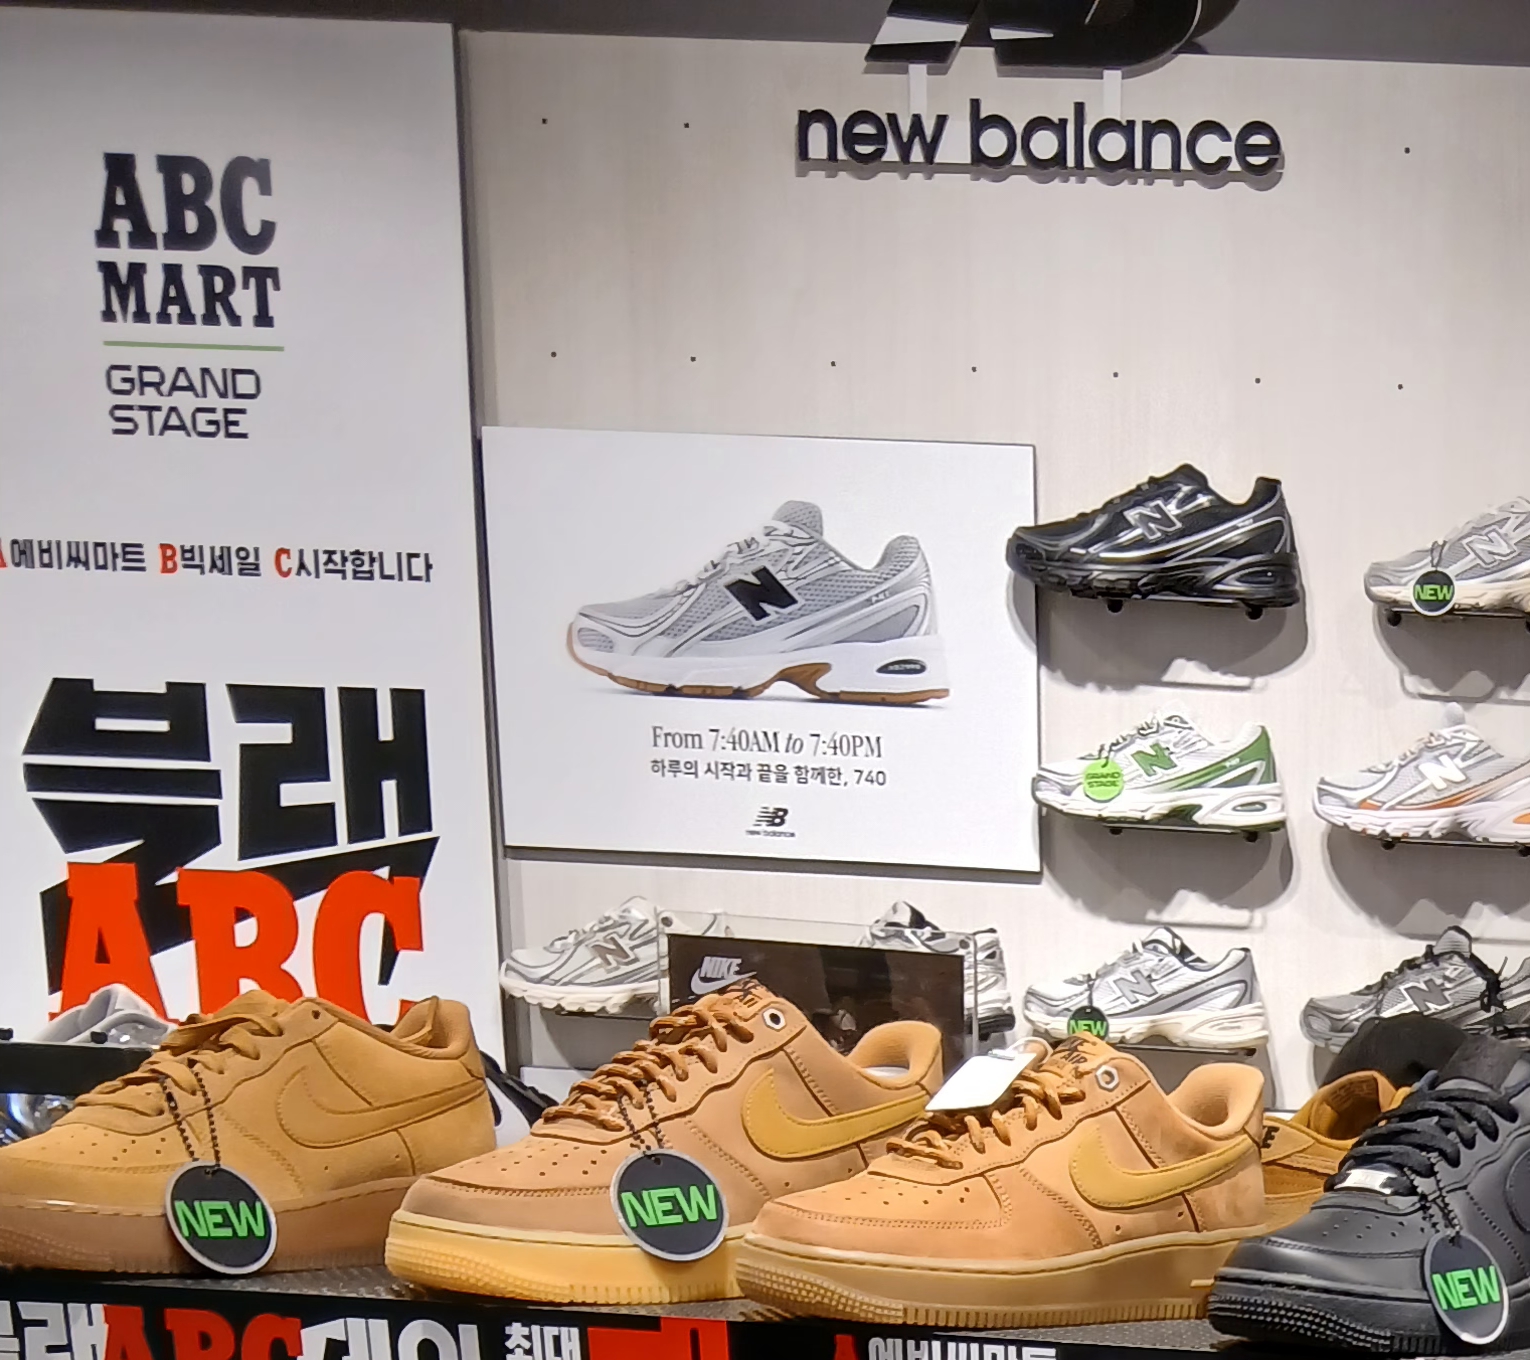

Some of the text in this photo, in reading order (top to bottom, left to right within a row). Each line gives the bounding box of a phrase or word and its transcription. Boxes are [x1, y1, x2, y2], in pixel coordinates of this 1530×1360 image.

[797, 99, 1283, 174] new balance
[95, 152, 277, 255] ABC
[97, 260, 281, 329] MART
[105, 364, 261, 400] GRAND
[109, 404, 249, 440] STAGE
[1414, 585, 1454, 601] NEW
[651, 725, 883, 758] From 7:40AM to 7:40PM
[650, 758, 887, 788] 하루의 시작과 끝을 함께한, 740
[49, 861, 425, 1022] ABC
[700, 956, 741, 979] NIKE
[1069, 1020, 1108, 1038] NEW
[175, 1201, 266, 1239] NEW
[620, 1185, 718, 1229] NEW
[1432, 1266, 1500, 1311] NEW
